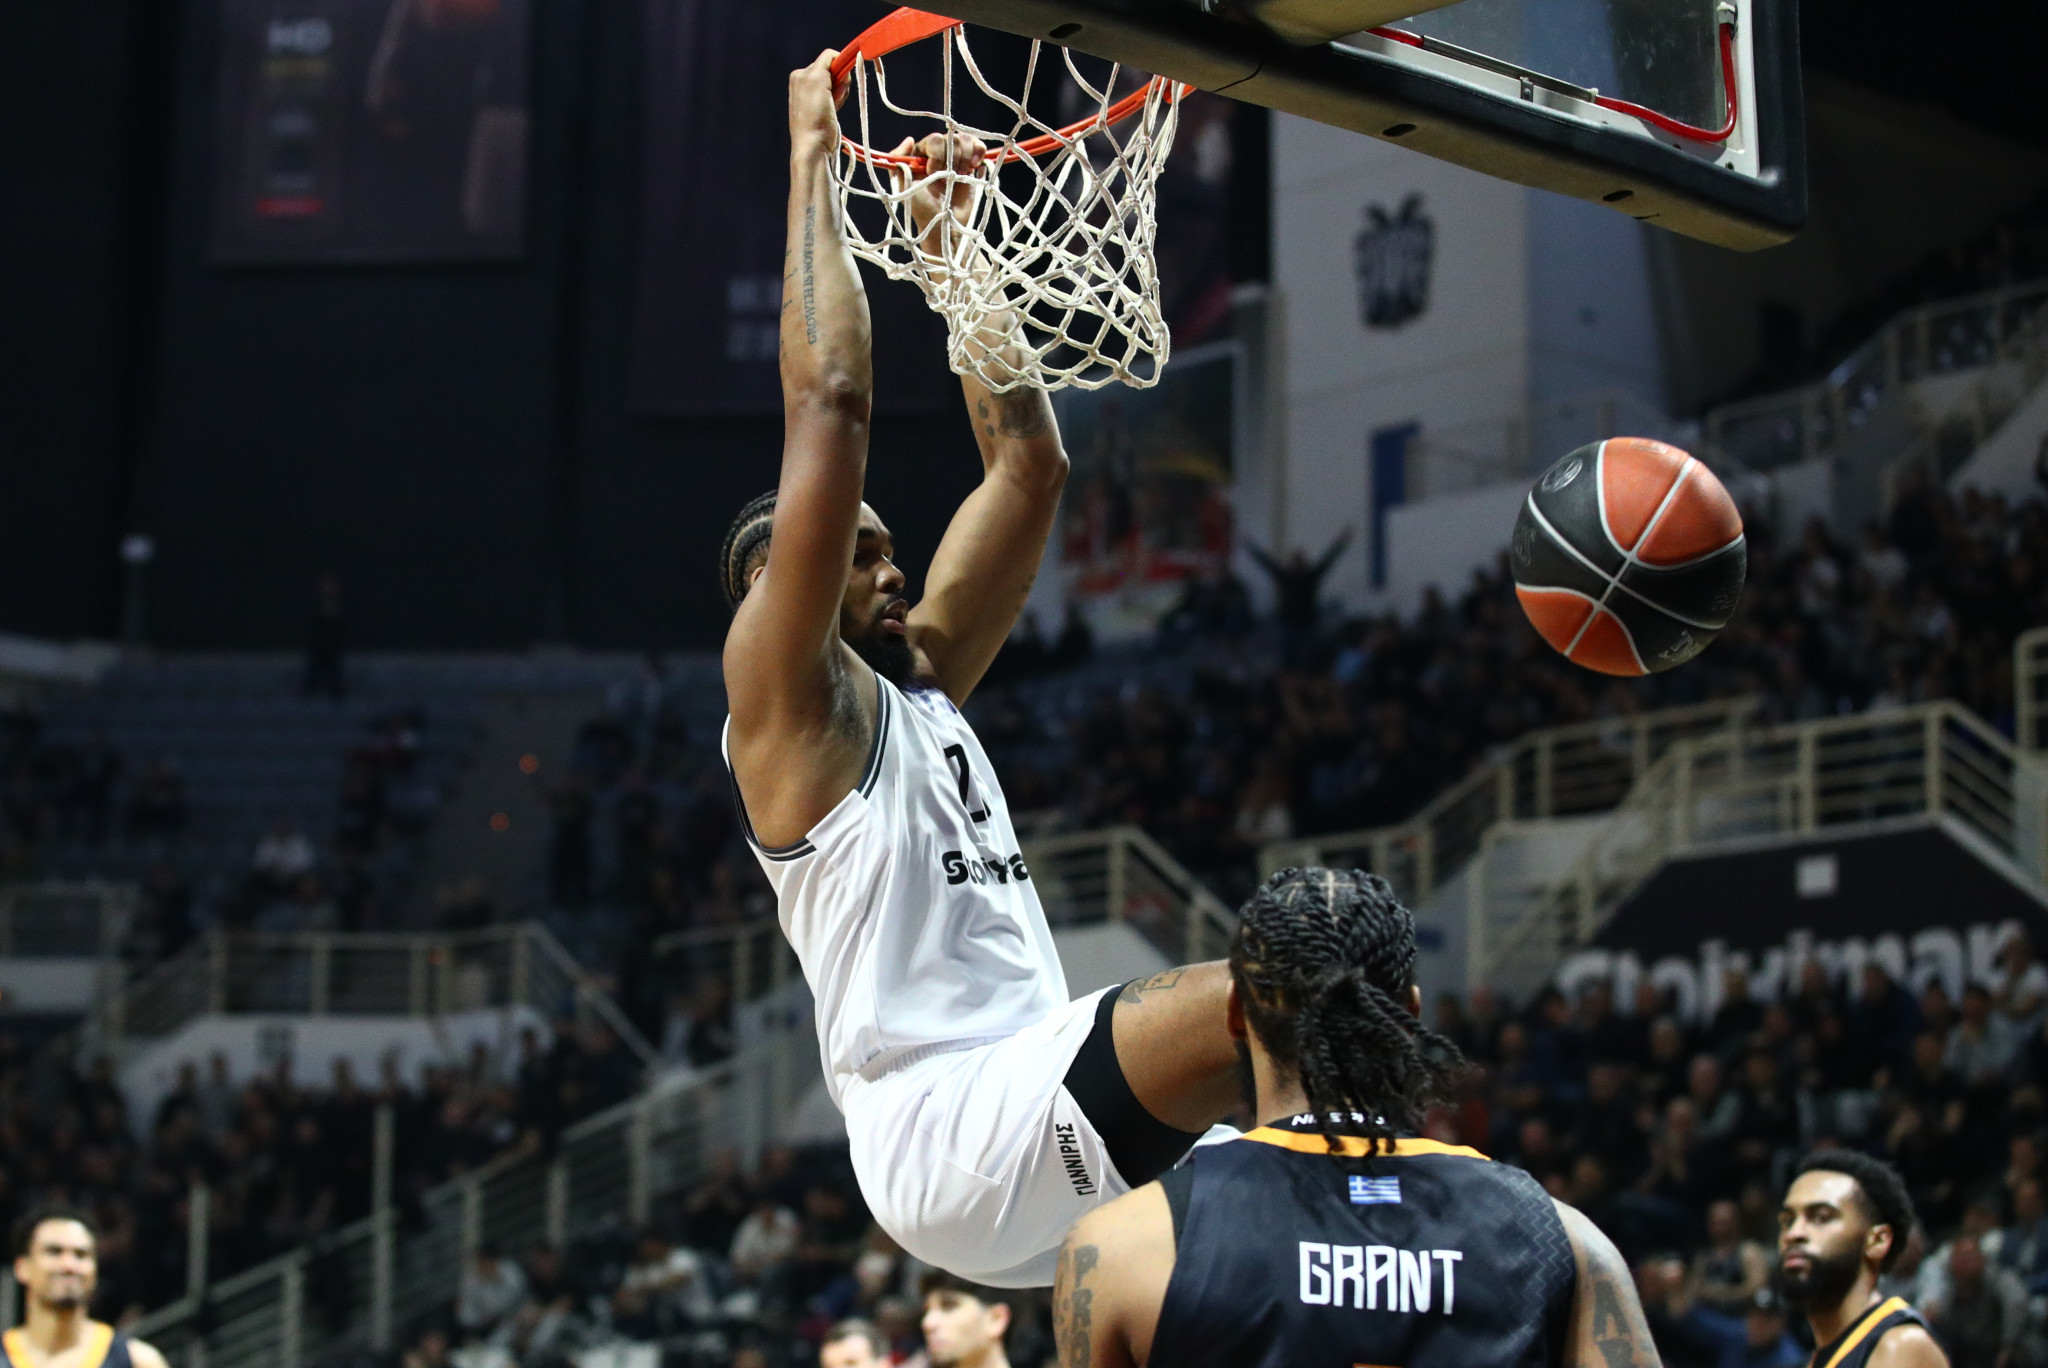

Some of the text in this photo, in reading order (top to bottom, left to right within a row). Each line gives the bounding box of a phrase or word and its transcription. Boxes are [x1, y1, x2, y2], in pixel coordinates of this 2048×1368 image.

[803, 249, 815, 274] NOT
[803, 275, 815, 287] IS
[803, 288, 818, 345] GROWTH
[1055, 1123, 1098, 1197] ΓΙΑΝΝΙΡΗΣ
[1299, 1241, 1463, 1315] GRANT
